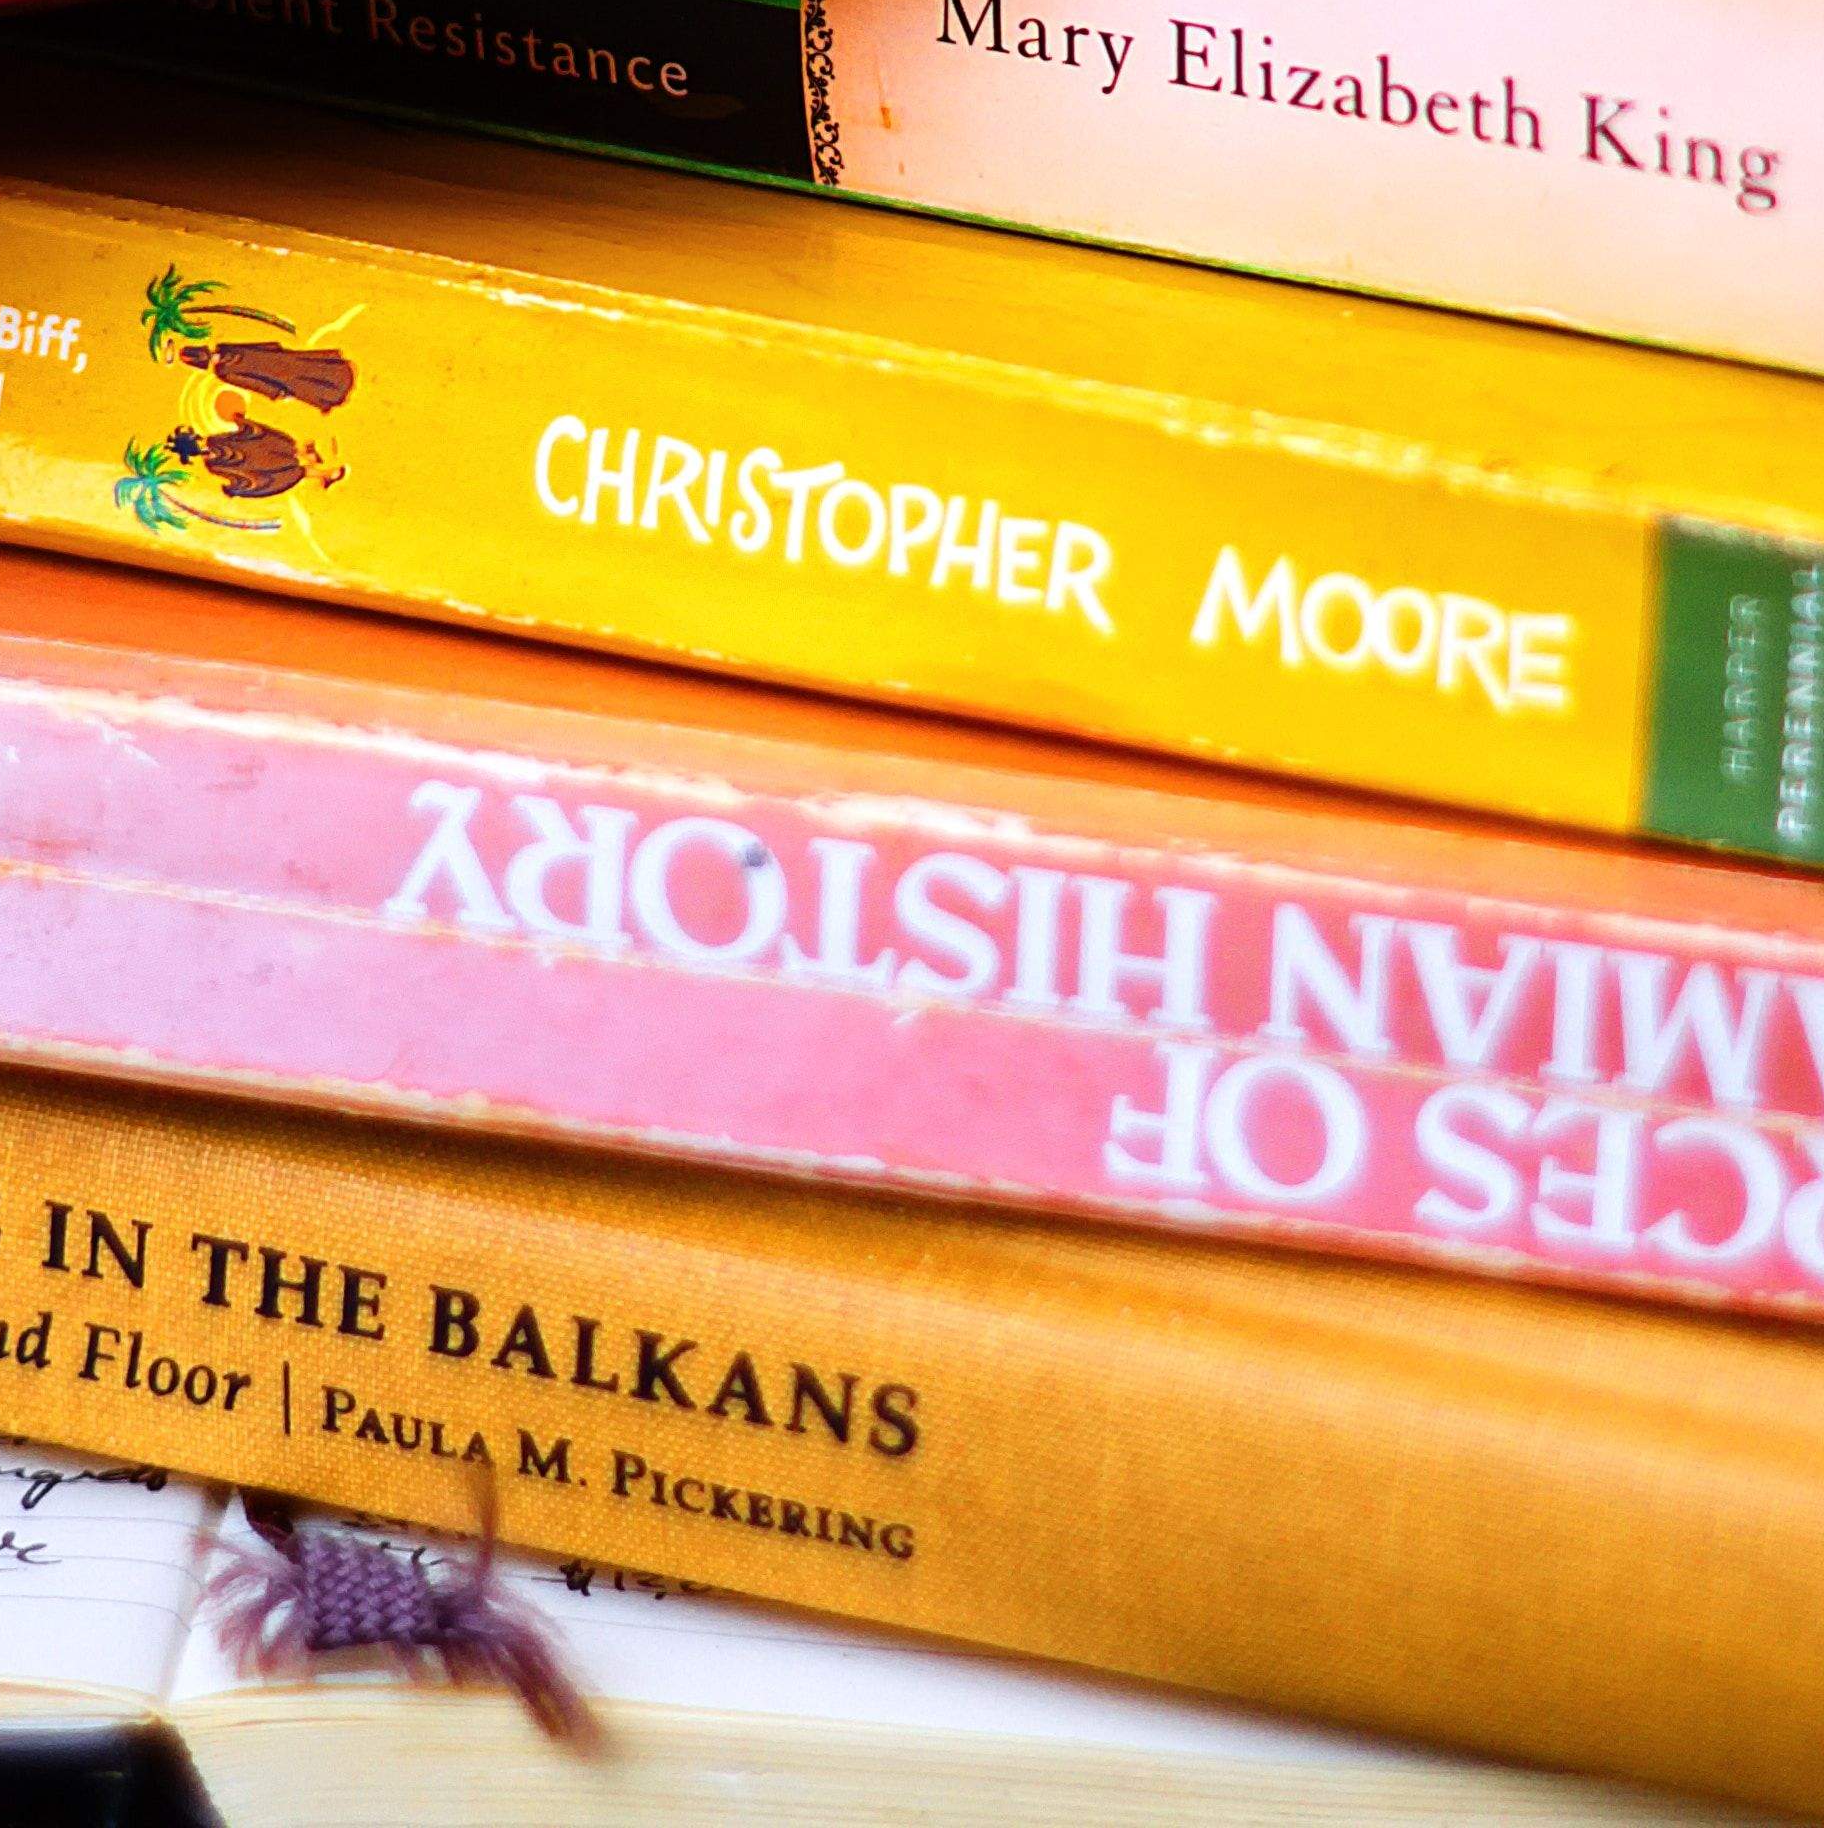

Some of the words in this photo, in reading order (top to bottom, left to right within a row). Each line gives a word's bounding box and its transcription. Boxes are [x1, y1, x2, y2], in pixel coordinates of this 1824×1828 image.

[1168, 18, 1547, 152] Elizabeth
[1580, 92, 1782, 214] King
[533, 413, 1116, 637] CHRISTOPHER
[1189, 544, 1573, 712] MOORE
[1722, 593, 1763, 781] HARPER
[383, 779, 1218, 1029] HISTORY
[1110, 1047, 1373, 1201] OF
[41, 1199, 153, 1289] IN
[190, 1231, 388, 1342] THE
[427, 1282, 921, 1459] BALKANS
[79, 1320, 253, 1412] Floor
[516, 1428, 589, 1489] M.
[610, 1448, 918, 1561] PICKERING
